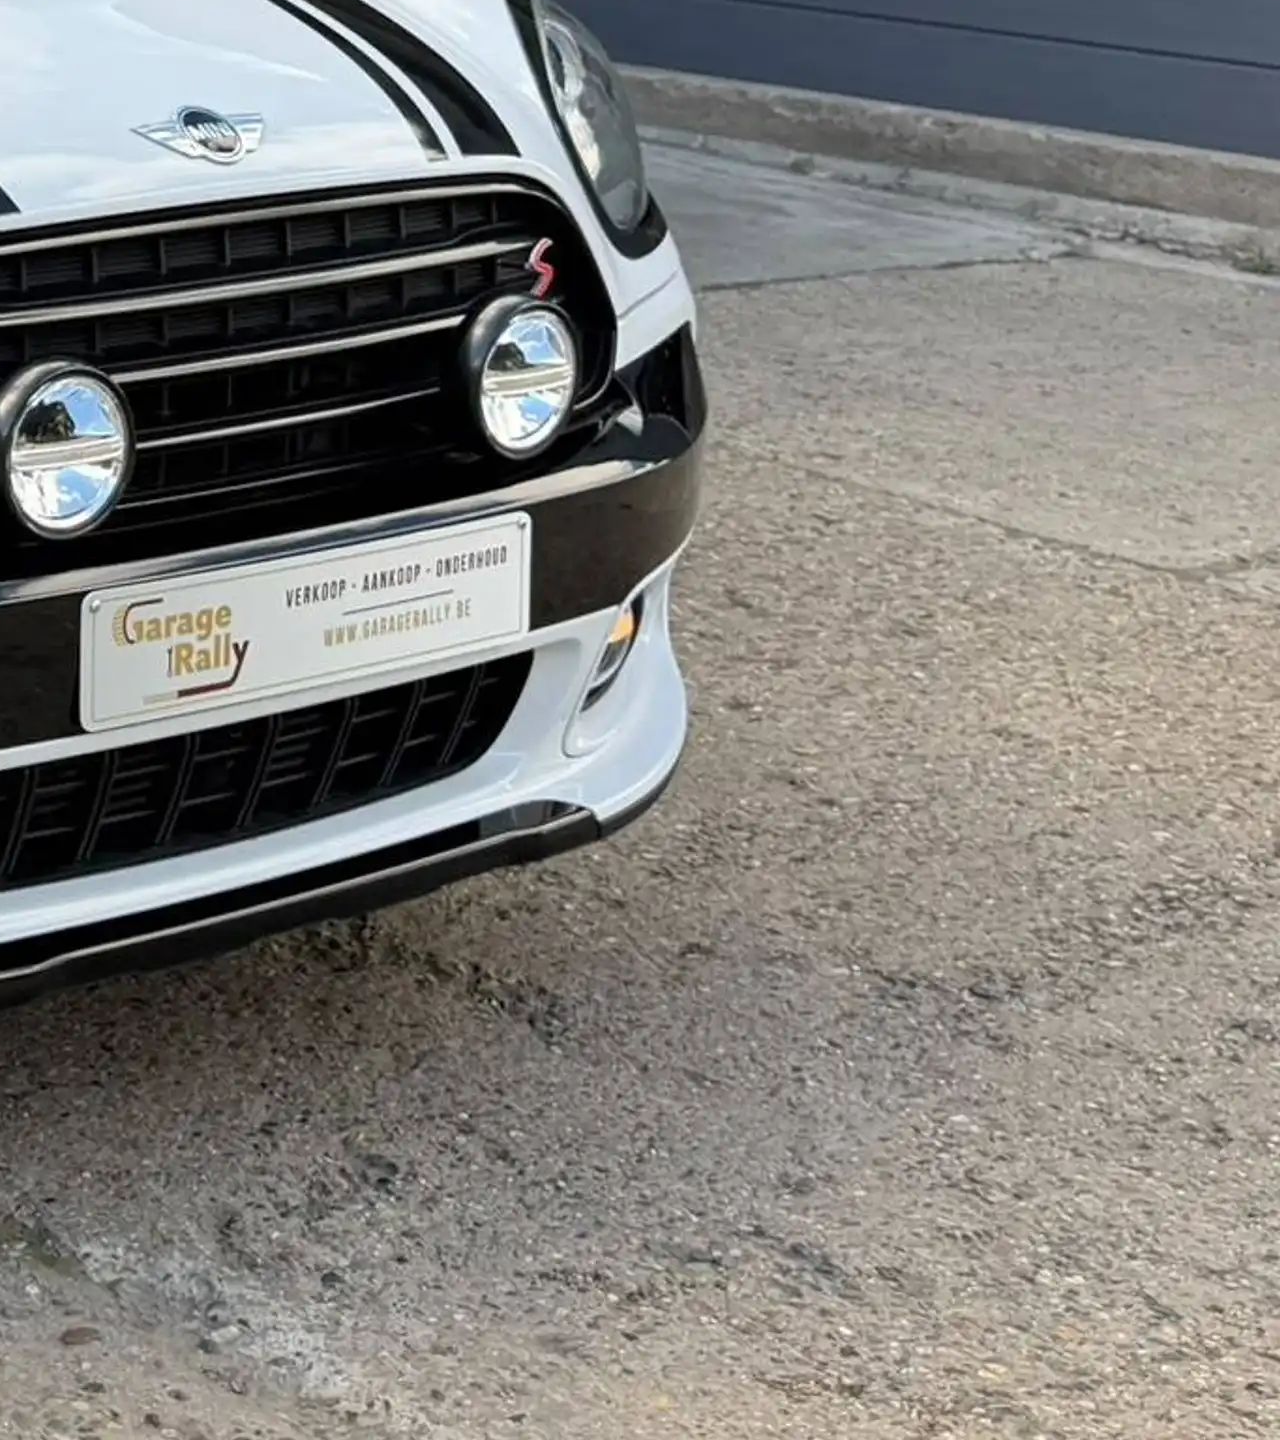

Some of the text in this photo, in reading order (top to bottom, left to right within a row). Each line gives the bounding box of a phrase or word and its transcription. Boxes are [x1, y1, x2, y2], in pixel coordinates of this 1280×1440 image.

[286, 578, 347, 608] VERKOOP
[361, 564, 421, 593] AANKOOP
[436, 545, 508, 578] ONDERHOUD
[112, 598, 232, 647] Garage
[174, 632, 250, 697] Rally
